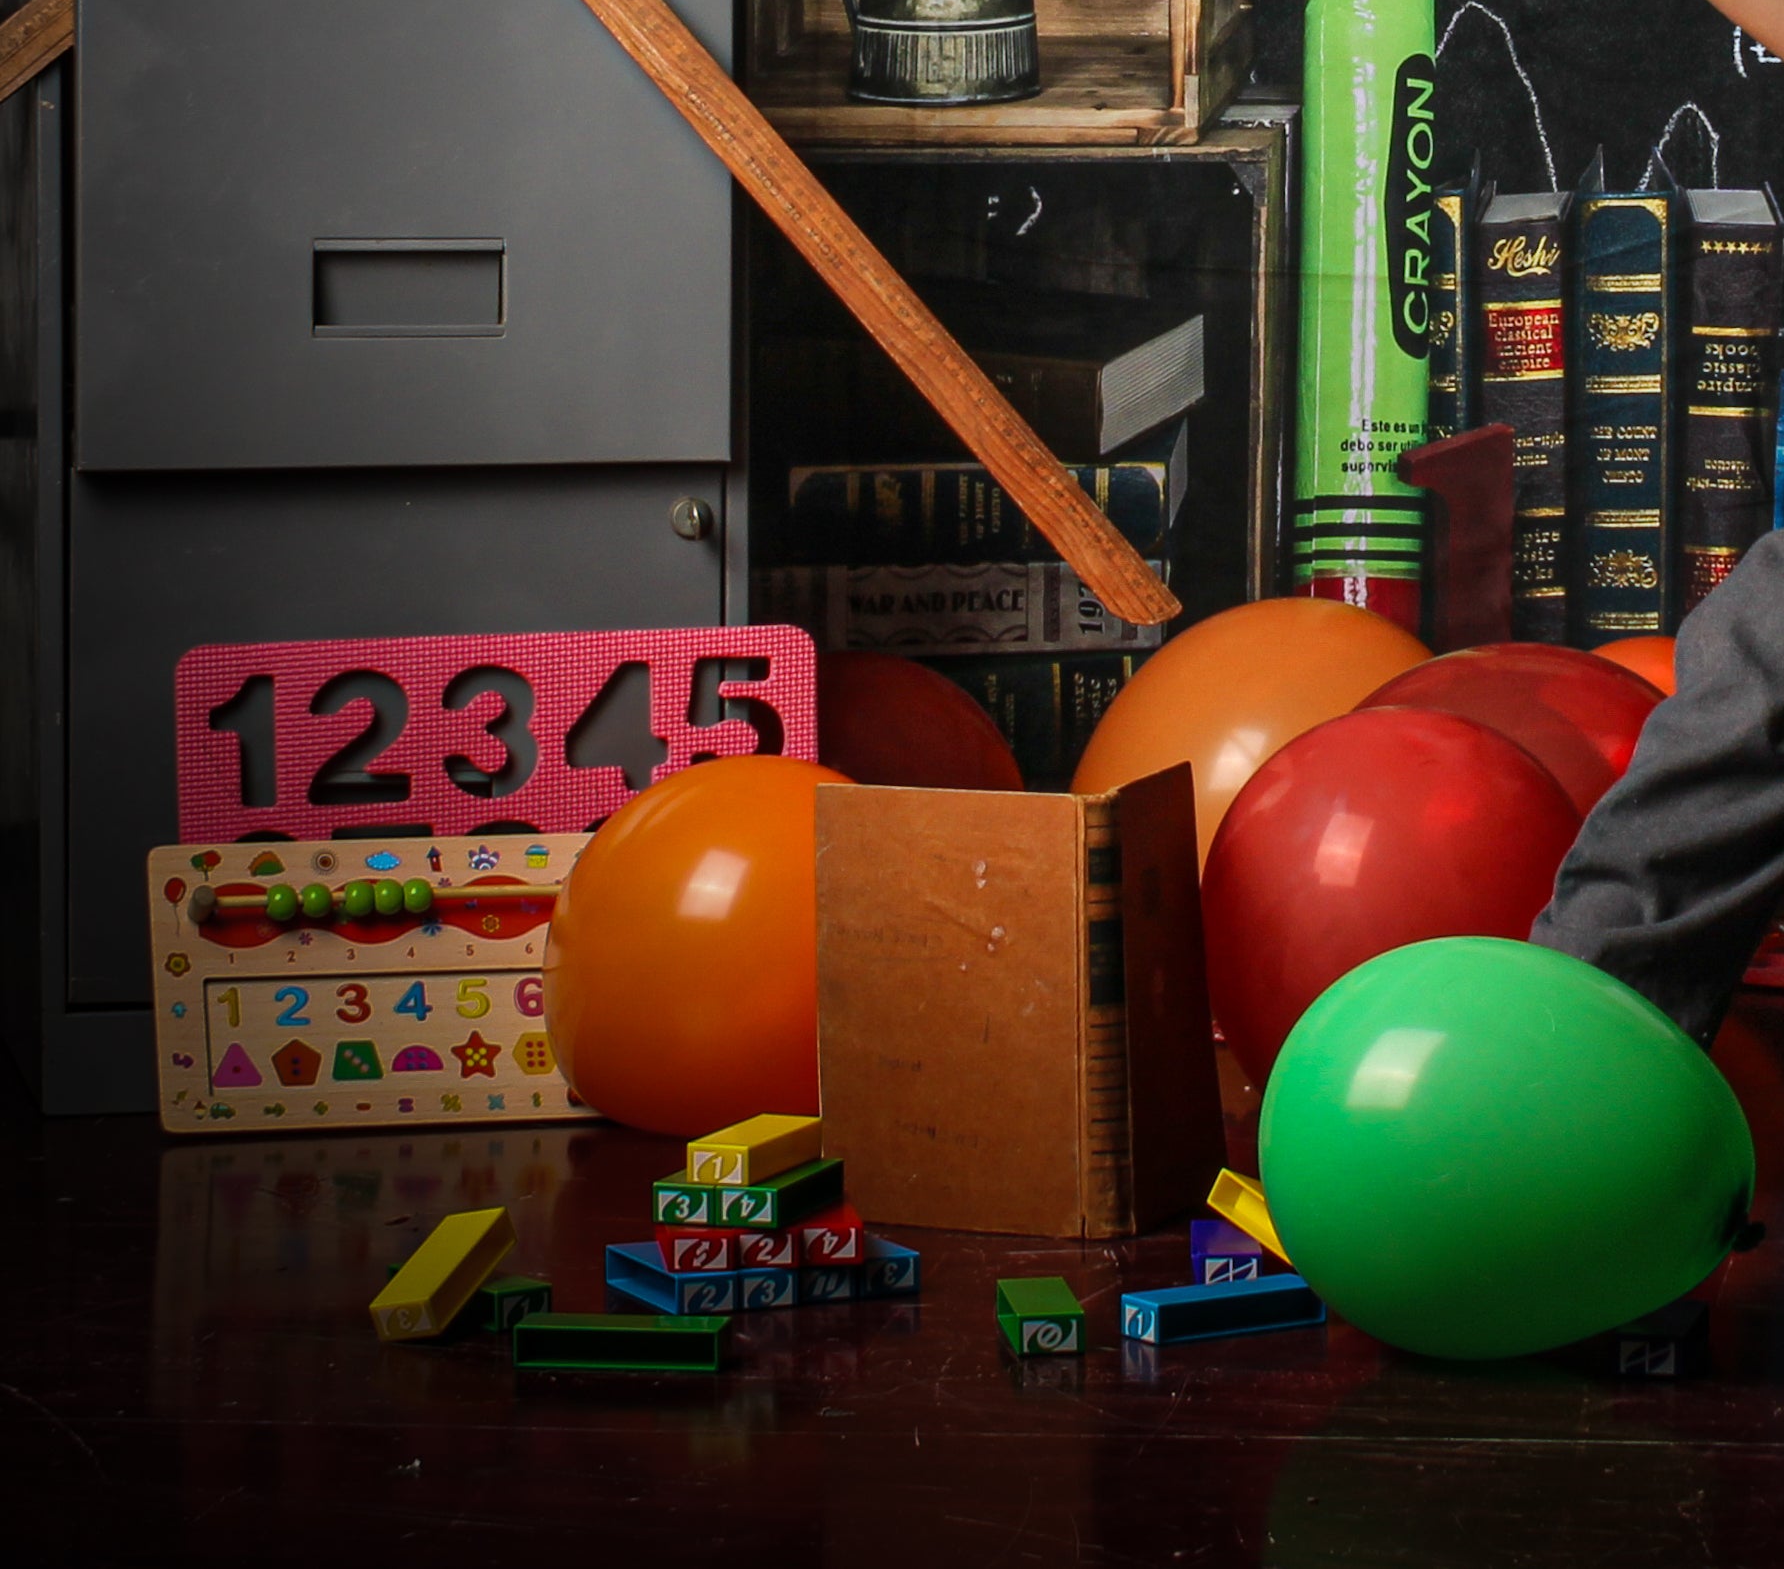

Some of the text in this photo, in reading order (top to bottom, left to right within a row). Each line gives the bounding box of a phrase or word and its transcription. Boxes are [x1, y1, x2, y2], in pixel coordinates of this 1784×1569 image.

[1402, 78, 1436, 336] CRAYON
[1488, 311, 1561, 332] European
[1494, 324, 1555, 341] classical
[1362, 419, 1391, 432] Este
[1340, 439, 1398, 452] debo ser
[850, 588, 1025, 615] WAR AND PEACE
[208, 655, 786, 807] 1 2 3 4 5
[286, 950, 296, 963] 2
[346, 948, 356, 961] 3
[406, 946, 416, 959] 4
[465, 944, 475, 957] 5
[524, 942, 534, 956] 6
[216, 976, 545, 1027] 1 2 3 4 5 6
[710, 1154, 725, 1181] 1
[674, 1193, 693, 1219] 3
[755, 1236, 776, 1262] 2
